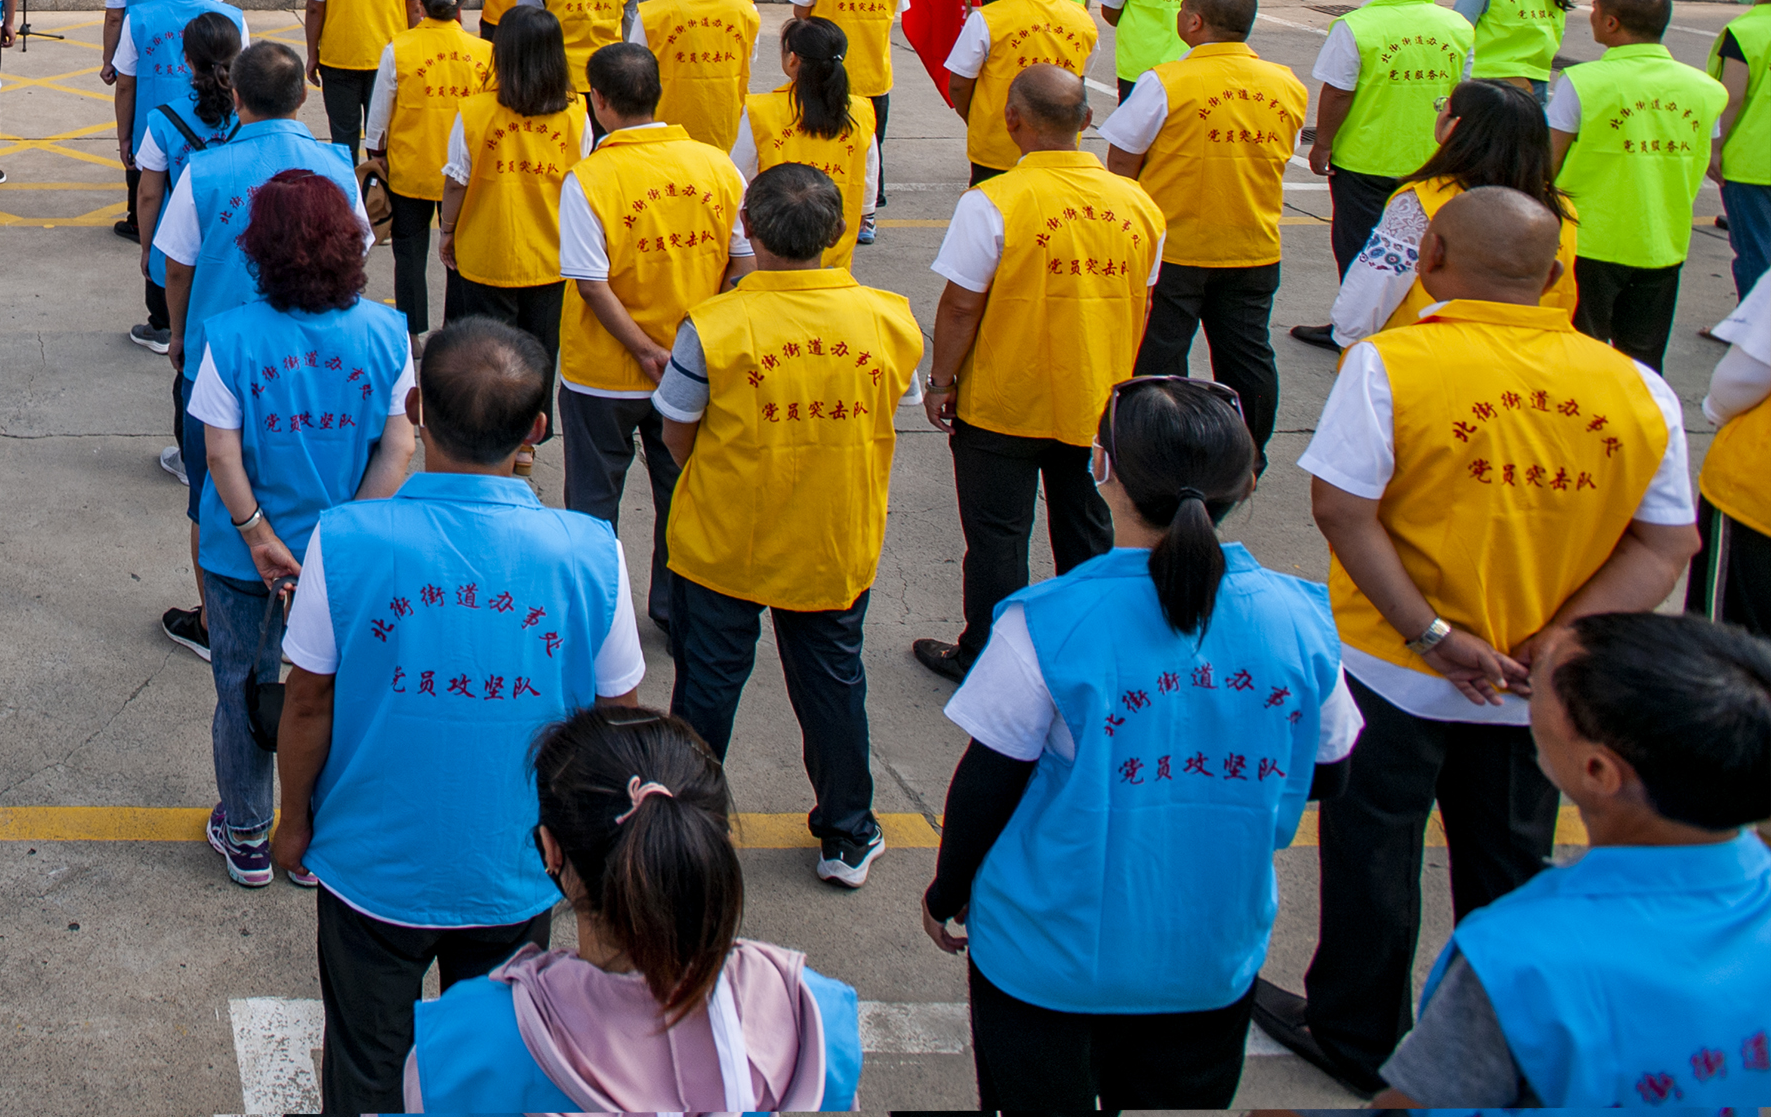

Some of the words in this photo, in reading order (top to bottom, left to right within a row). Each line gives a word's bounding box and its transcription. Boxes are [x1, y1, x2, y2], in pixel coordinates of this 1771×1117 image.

[250, 349, 375, 401] 北街街道办事处
[747, 337, 884, 388] 北街街道办事处
[263, 410, 356, 433] 党员攻坚队
[761, 400, 869, 423] 党员突击队
[1452, 390, 1624, 459] 北街街道办事处
[1468, 458, 1597, 492] 党员突击队
[369, 582, 565, 659] 北街街道办事处
[1117, 751, 1287, 785] 党员攻坚队
